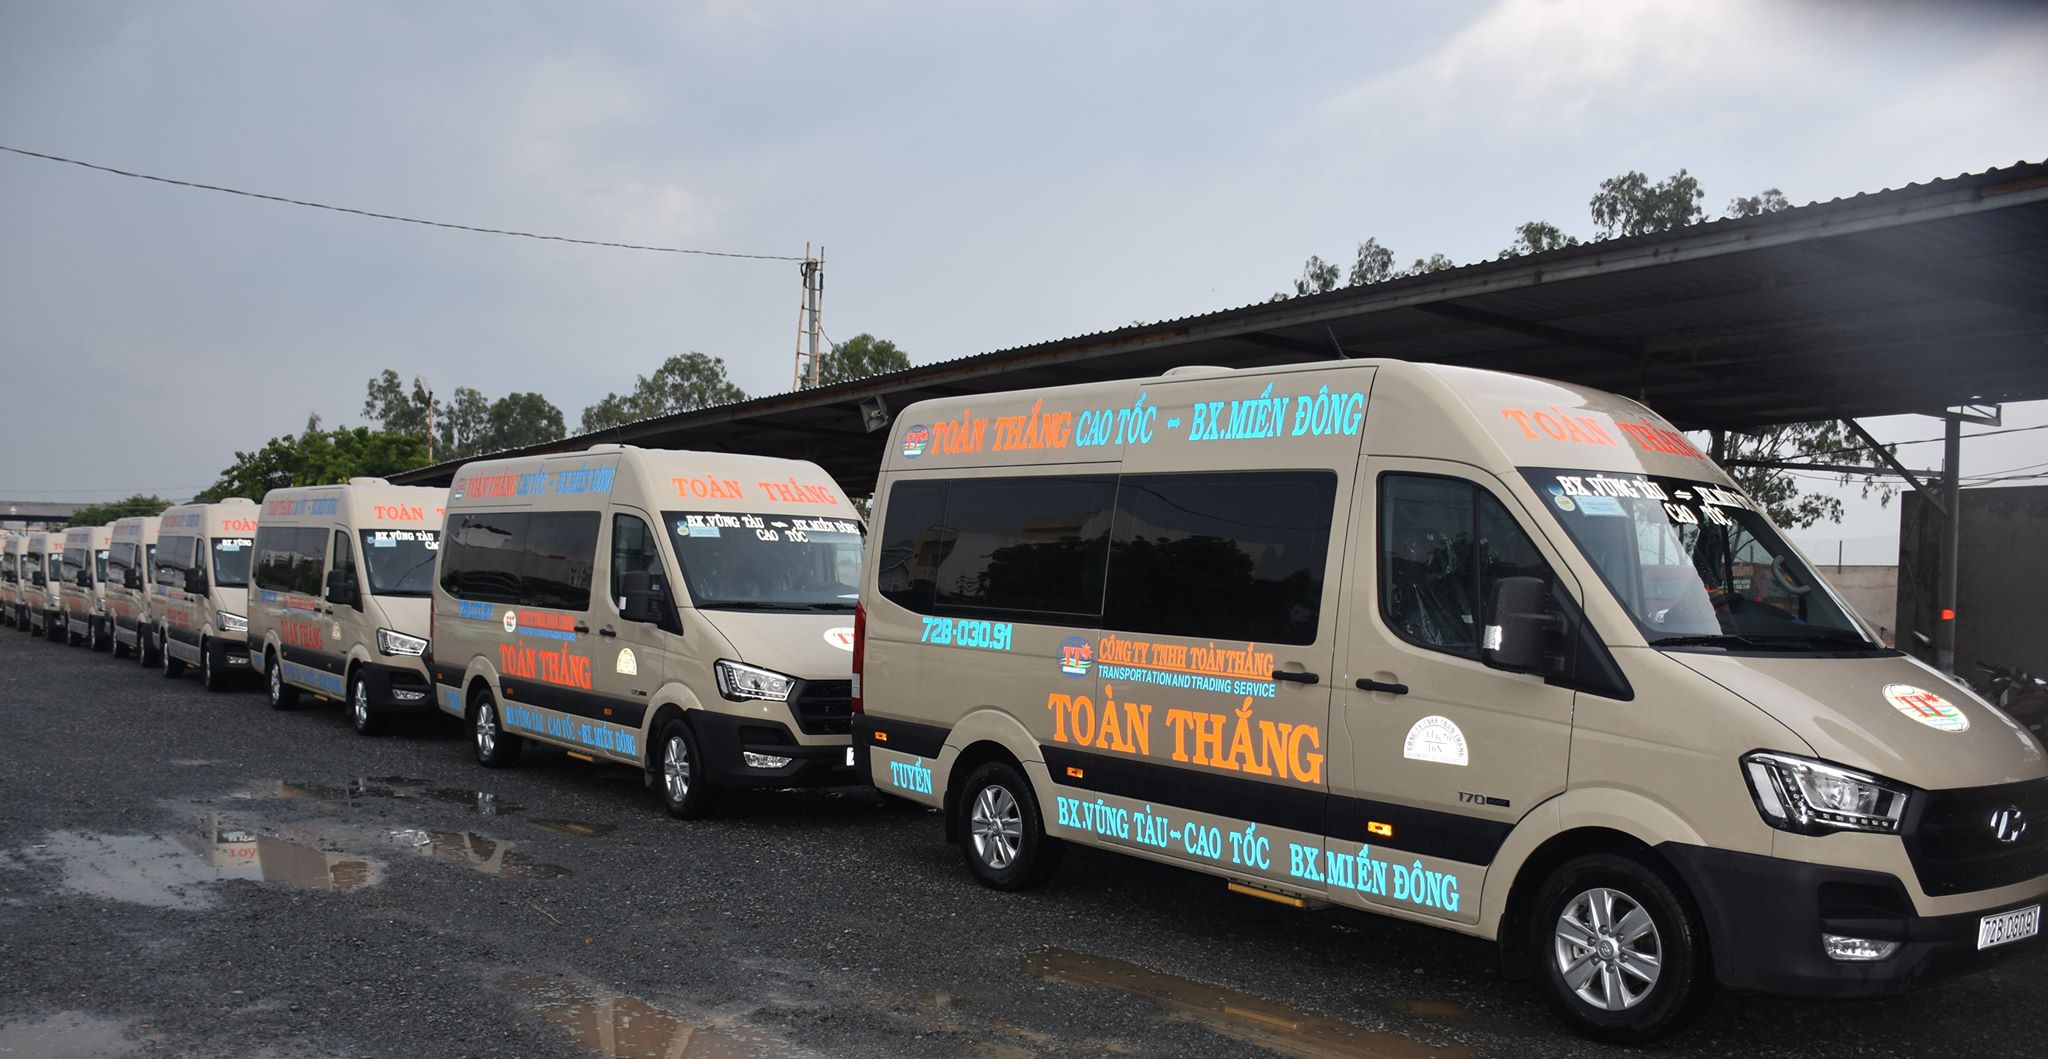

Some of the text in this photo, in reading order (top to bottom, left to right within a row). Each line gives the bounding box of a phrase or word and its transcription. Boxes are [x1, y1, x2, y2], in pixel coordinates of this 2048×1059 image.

[931, 409, 988, 454] TOÀN
[1075, 409, 1114, 447] CAO
[1115, 391, 1156, 445] TỐC
[1292, 385, 1364, 436] ĐÔNG
[1502, 406, 1617, 446] TOÀN
[671, 473, 744, 499] TOÀN
[374, 503, 424, 520] TOÀN
[1664, 502, 1698, 524] CAO
[756, 529, 779, 542] CAO
[921, 616, 1013, 650] 72B-030.91
[499, 638, 536, 679] TOÀN
[1099, 634, 1132, 662] CÔNG
[1132, 641, 1149, 664] TY
[1152, 643, 1187, 668] TNHH
[1190, 641, 1227, 673] TOÀN
[1098, 665, 1275, 698] TRANSPORTATION AND TRADING SERVICE
[1048, 684, 1324, 784] TOÀN THẮNG
[891, 757, 932, 794] TUYẾN
[1057, 796, 1129, 840] BX.VŨNG
[1134, 804, 1168, 848] TÀU
[1184, 821, 1221, 860] CAO
[1229, 822, 1270, 870] TỐC
[1393, 859, 1459, 912] ĐÔNG
